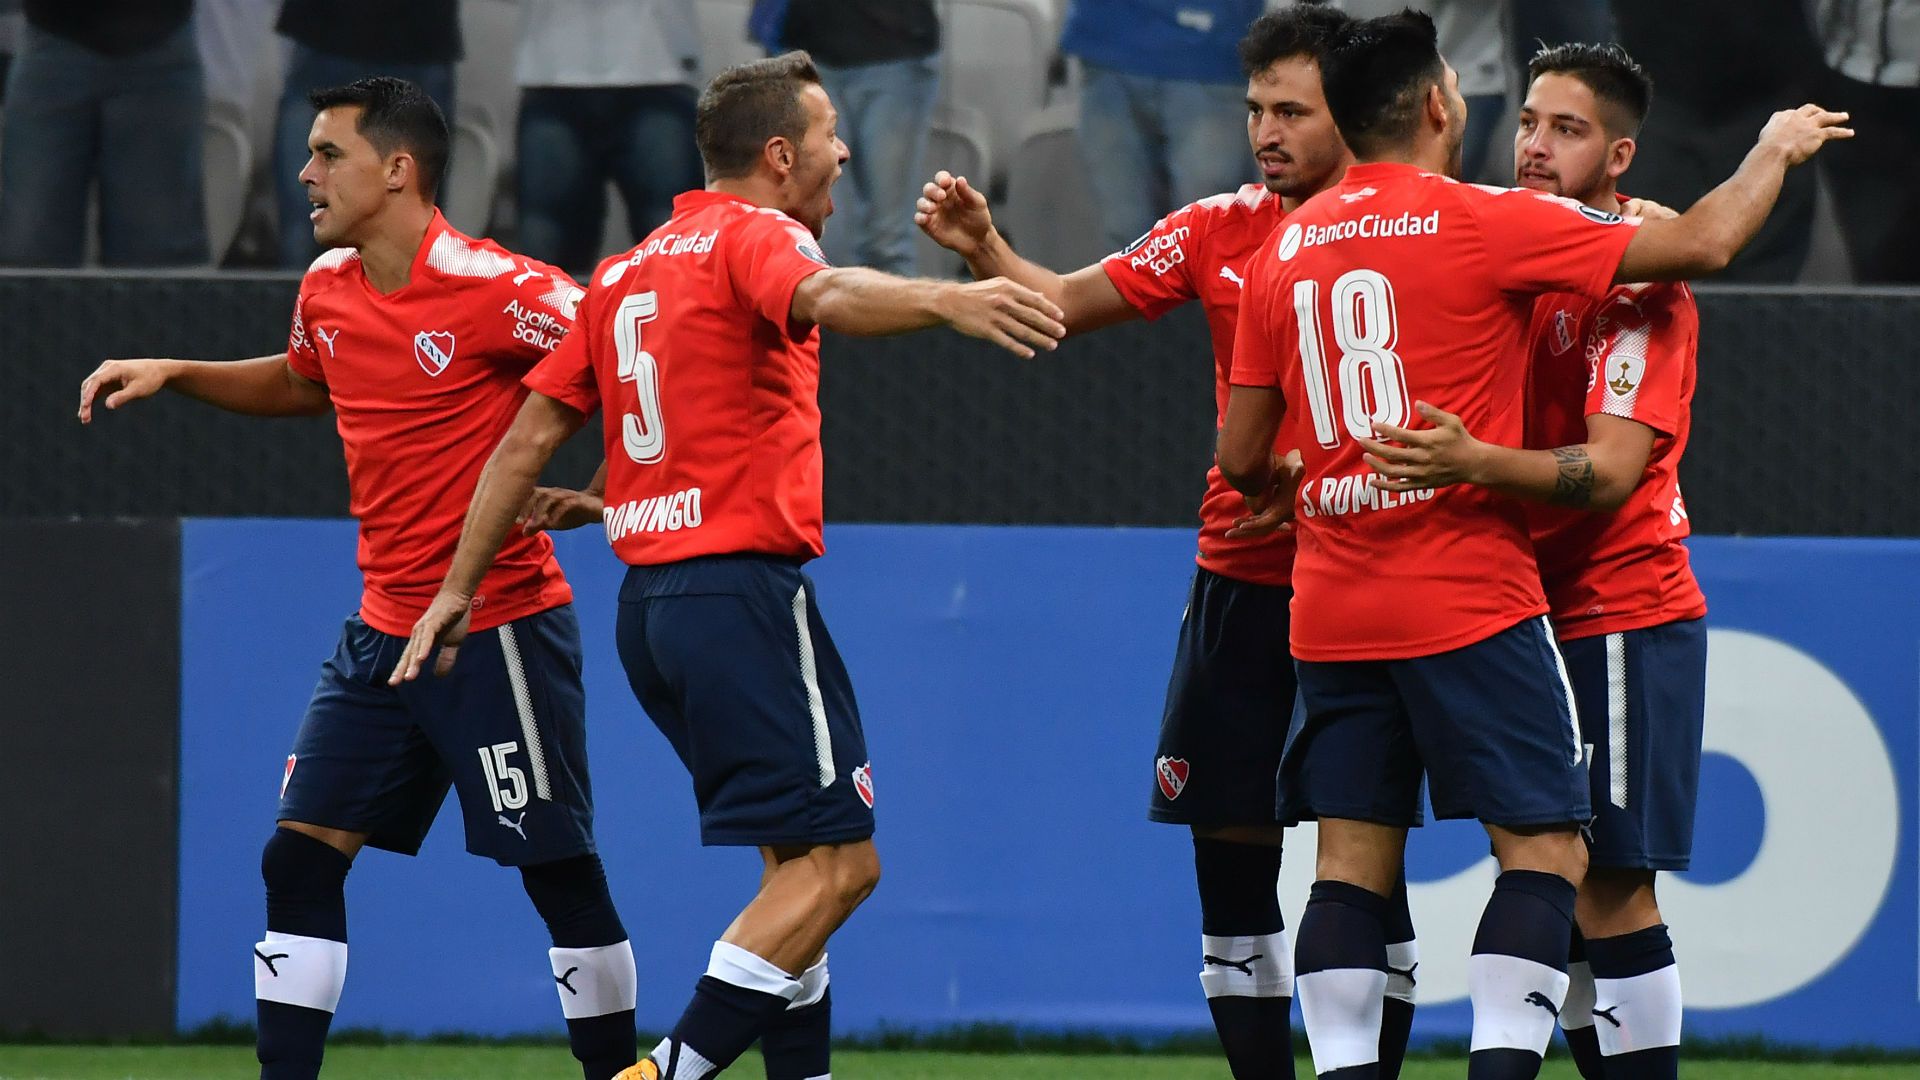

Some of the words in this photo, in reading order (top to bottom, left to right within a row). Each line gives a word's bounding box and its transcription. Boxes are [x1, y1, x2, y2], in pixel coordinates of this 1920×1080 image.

[1303, 210, 1439, 247] BancoCiudad
[503, 299, 570, 337] Audifar
[614, 290, 666, 465] 5
[1293, 268, 1411, 450] 18
[603, 487, 702, 546] DOMINGO
[478, 741, 529, 812] 15
